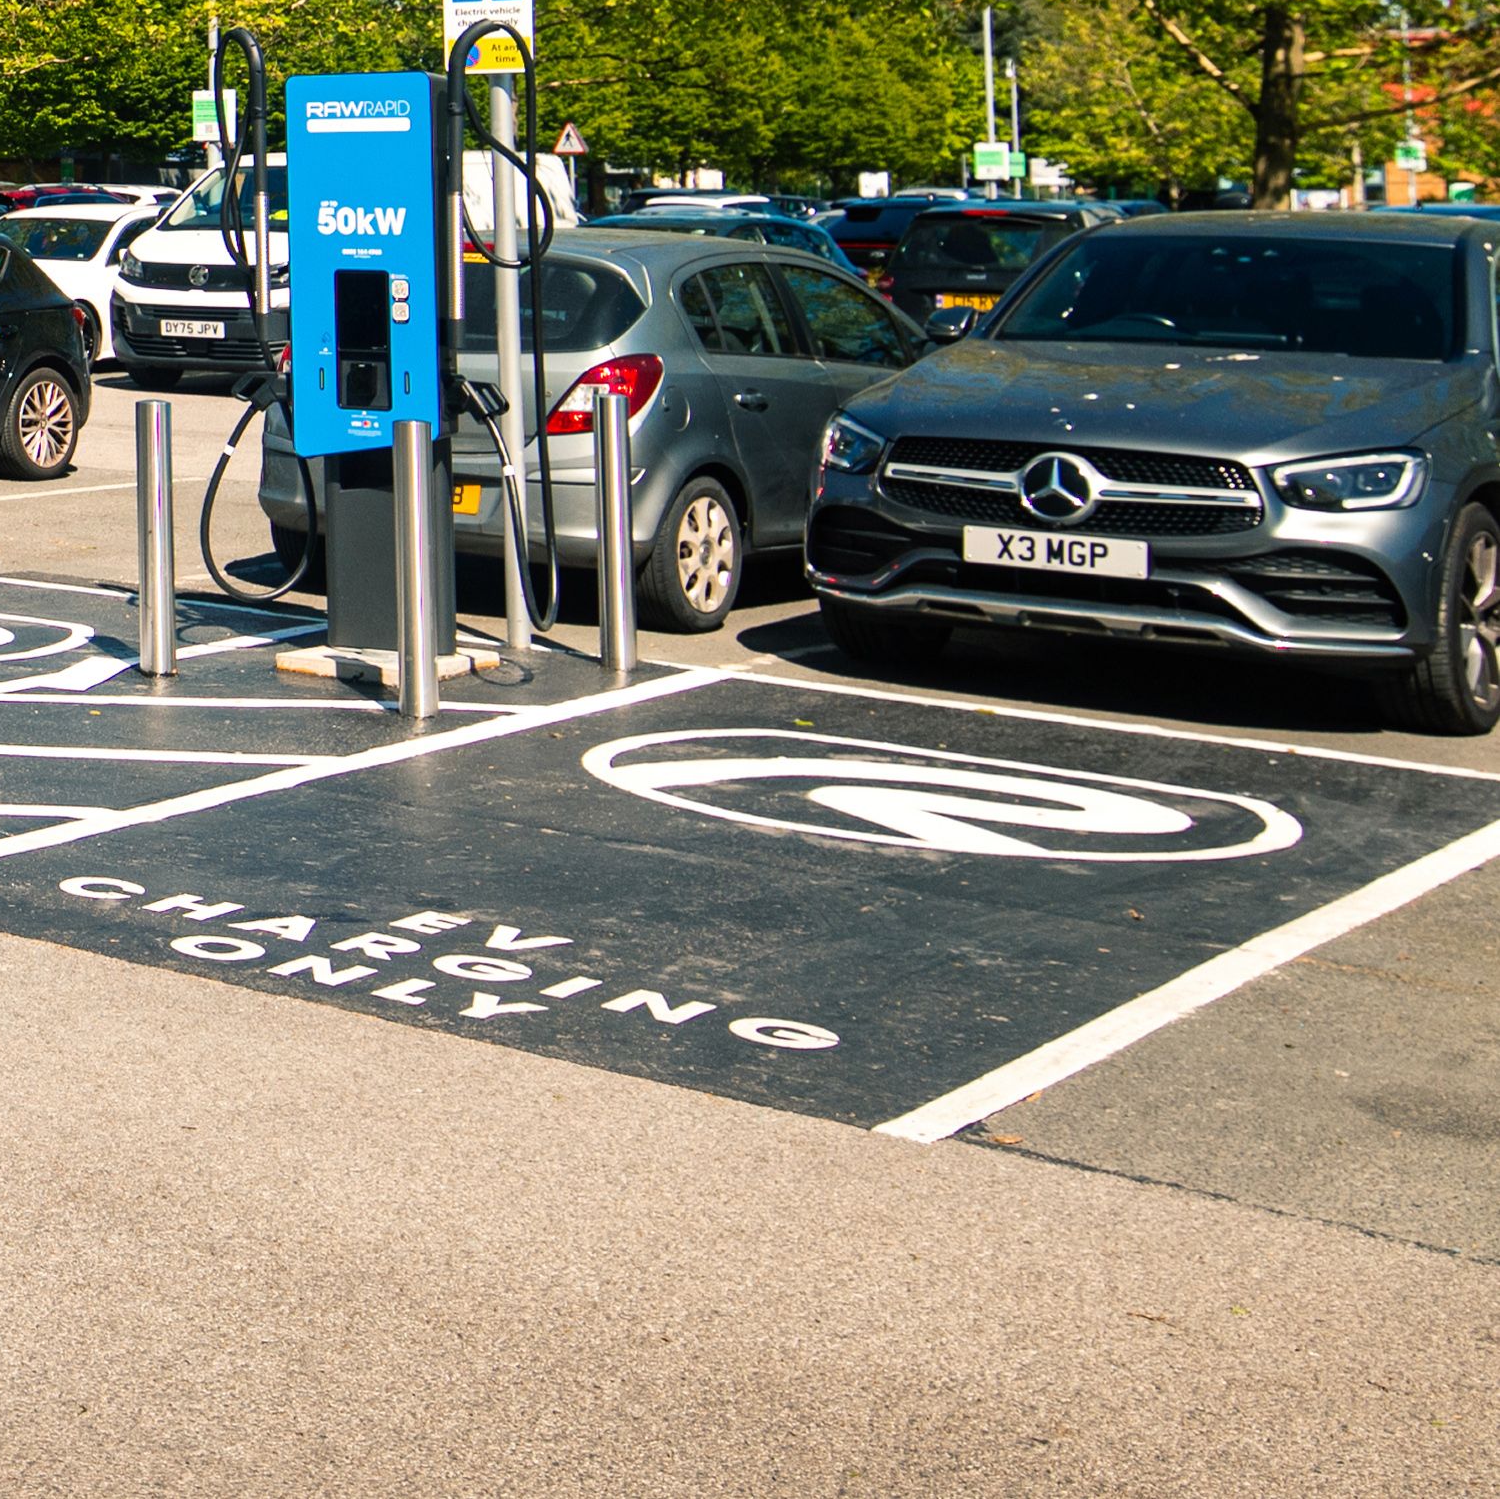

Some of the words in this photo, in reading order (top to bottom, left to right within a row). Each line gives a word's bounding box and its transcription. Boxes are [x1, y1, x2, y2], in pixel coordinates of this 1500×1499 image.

[455, 8, 487, 16] Electric
[490, 7, 520, 15] vehicle
[317, 206, 407, 236] 50kW
[165, 322, 194, 334] DY75
[197, 323, 219, 335] JPV
[997, 533, 1036, 562] X3
[1046, 538, 1109, 568] MGP
[390, 911, 575, 951] EV
[58, 876, 842, 1050] CHARGING
[169, 934, 549, 1020] ONLY
